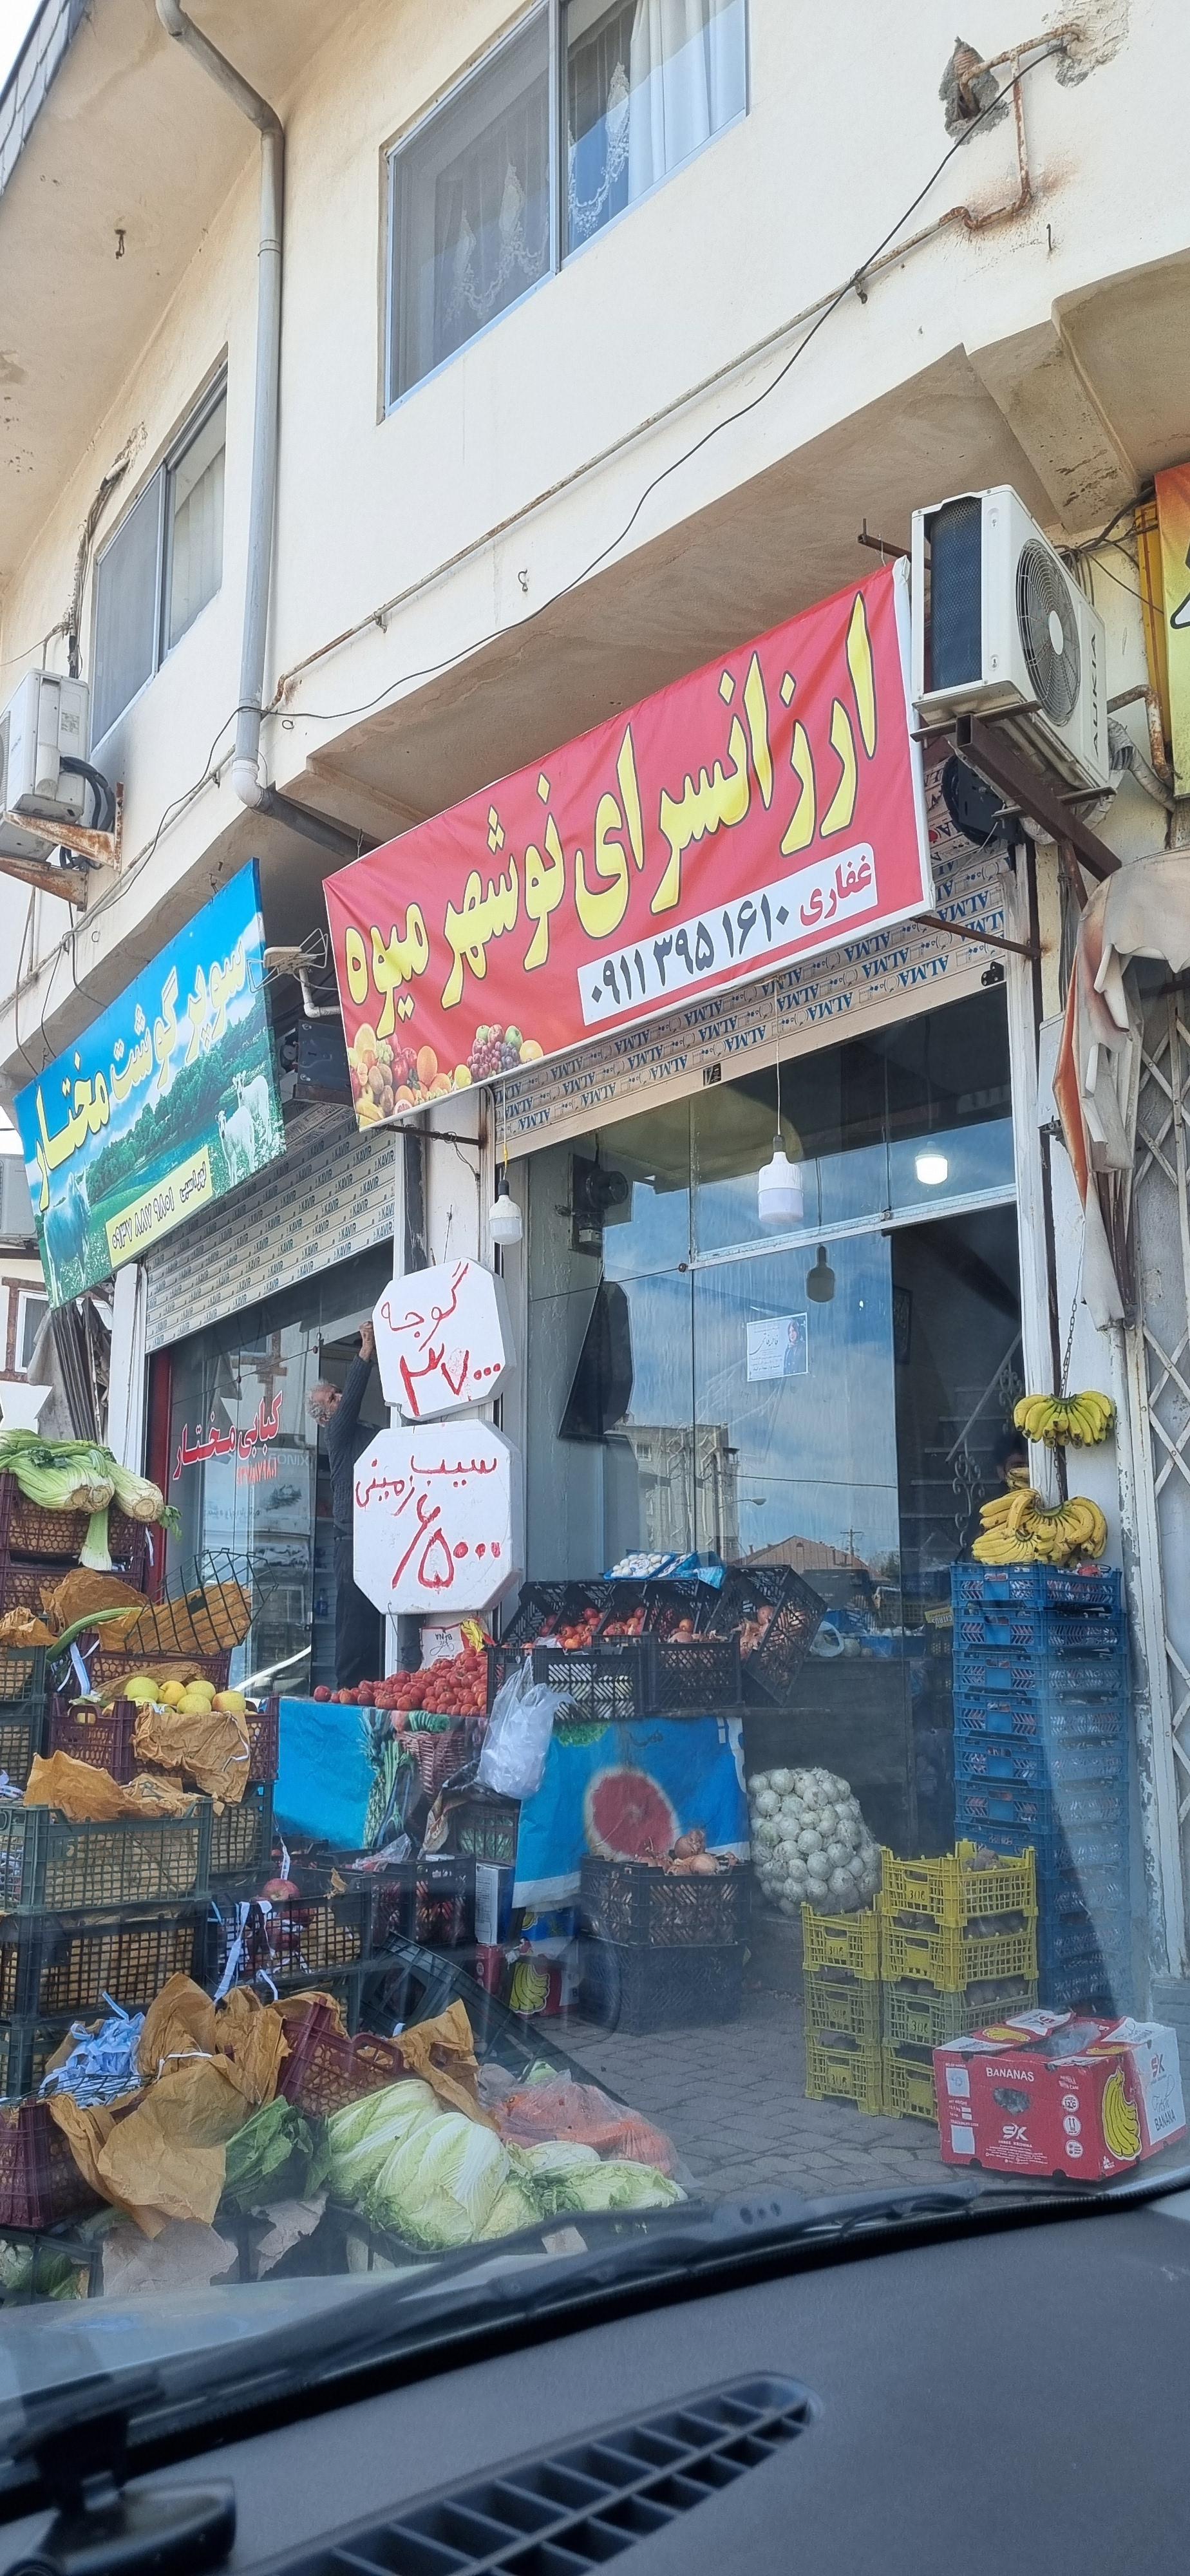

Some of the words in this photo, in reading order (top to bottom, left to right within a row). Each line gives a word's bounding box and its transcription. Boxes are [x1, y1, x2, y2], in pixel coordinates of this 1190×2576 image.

[441, 773, 565, 1010] نوشهر
[799, 855, 873, 926] غفاری
[345, 902, 430, 1039] میوه
[591, 948, 646, 1005] ۰۹۱۱
[652, 920, 715, 987] ۳۹۵
[721, 893, 790, 958] ۱۶۱۰
[684, 999, 723, 1027] ALMA
[844, 931, 890, 962] ALMA
[937, 890, 988, 922] ALMA
[698, 1016, 737, 1042] ALMA
[777, 983, 820, 1012] ALMA
[861, 947, 909, 979] ALMA
[110, 966, 180, 1102] گوشت
[185, 937, 246, 1066] سوپر
[582, 1082, 616, 1106] ALMA
[652, 1054, 688, 1081] ALMA
[725, 1025, 766, 1052] ALMA
[807, 992, 854, 1021] ALMA
[899, 954, 949, 987] ALMA
[35, 1052, 110, 1213] مختار
[135, 1202, 152, 1237] ۸۸۷
[153, 1186, 175, 1222] ۹۸۰۱
[381, 1261, 469, 1352] گوجه
[238, 1390, 283, 1461] کبابی
[399, 1343, 501, 1417] ۳۷۰۰۰
[173, 1411, 237, 1481] مختار
[355, 1459, 415, 1517] زمینی
[410, 1455, 497, 1487] سیب
[986, 2067, 1034, 2082] BANANAS
[1155, 2109, 1176, 2131] BANANA
